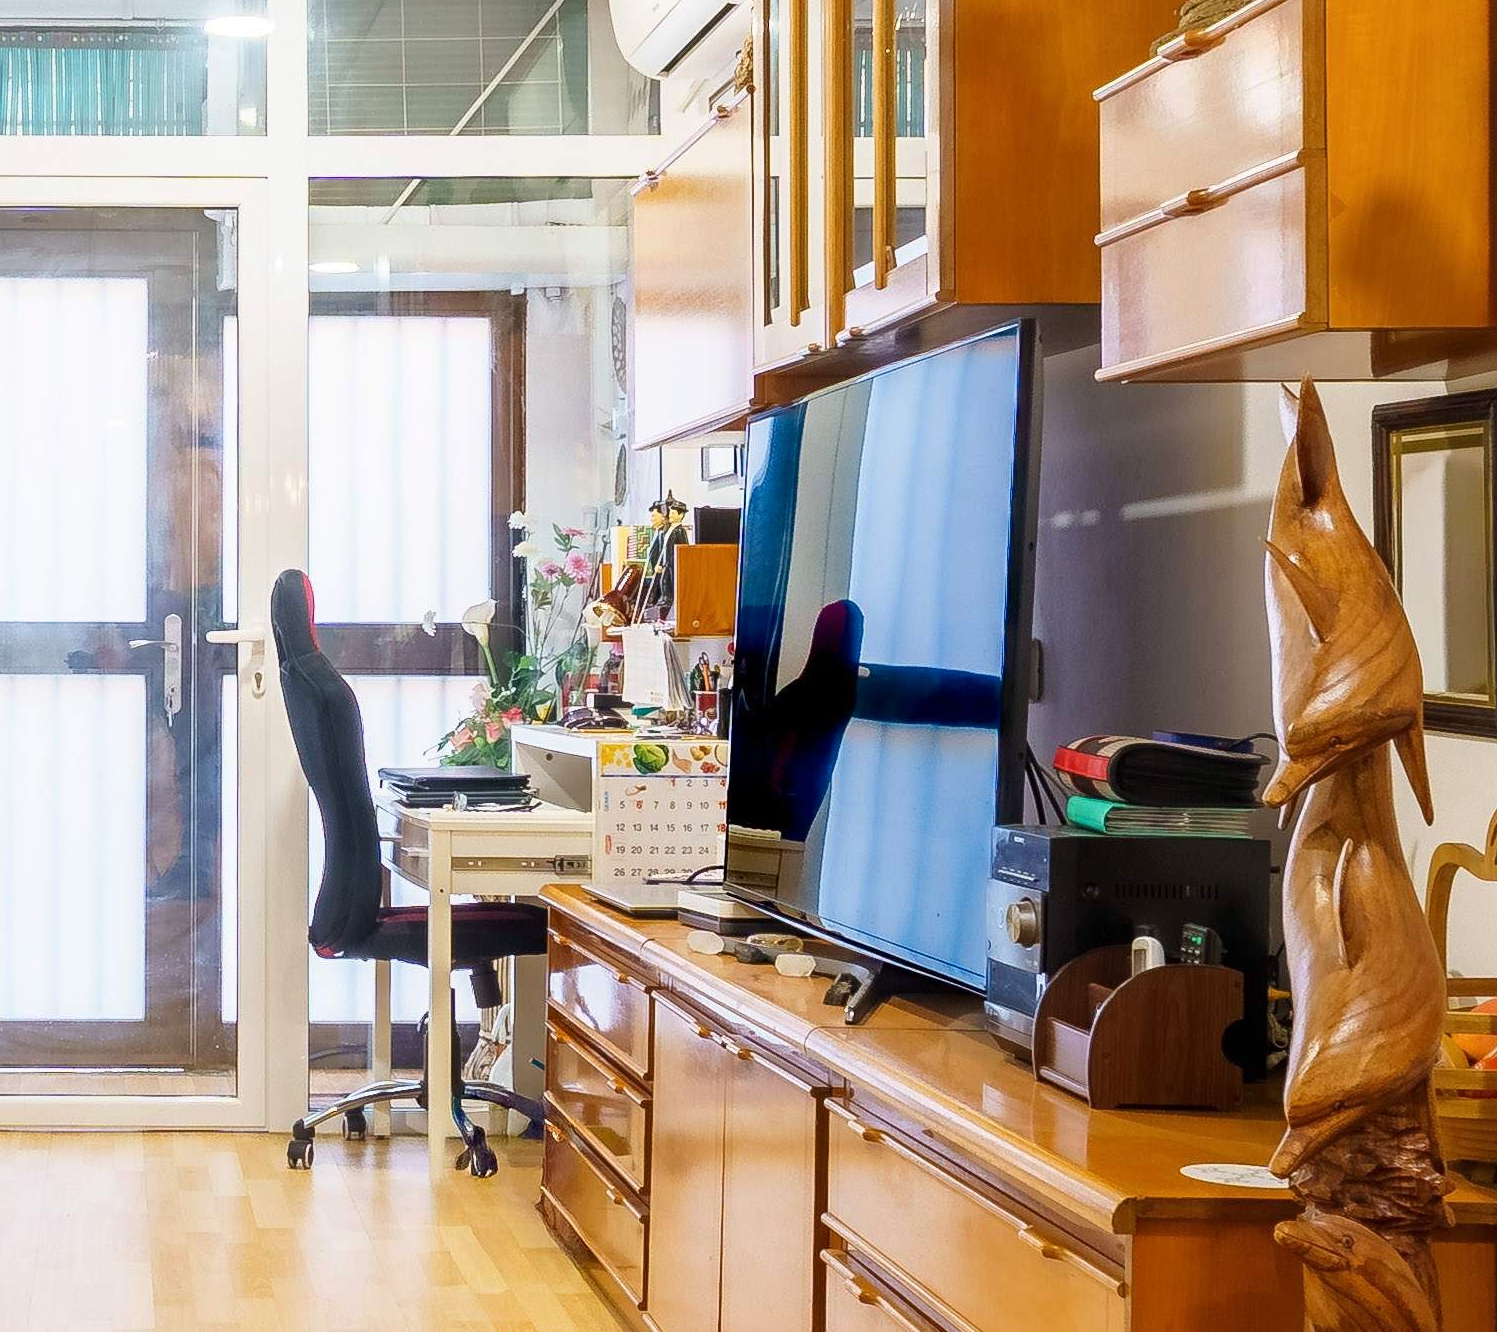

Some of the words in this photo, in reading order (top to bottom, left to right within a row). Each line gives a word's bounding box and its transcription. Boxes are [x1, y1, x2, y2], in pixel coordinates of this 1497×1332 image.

[686, 779, 692, 788] 2
[703, 779, 709, 788] 3
[619, 801, 625, 809] 5
[636, 800, 643, 809] 6
[654, 801, 660, 809] 7
[669, 801, 676, 809] 8
[686, 801, 692, 809] 9
[700, 801, 709, 809] 10
[616, 823, 625, 832] 12
[632, 823, 642, 832] 13
[649, 823, 659, 832] 14
[666, 823, 675, 832] 15
[683, 823, 692, 832] 16
[700, 823, 709, 832] 17
[616, 846, 625, 854] 19
[631, 846, 642, 854] 20
[649, 846, 659, 854] 21
[665, 846, 676, 854] 22
[682, 846, 692, 854] 23
[698, 846, 709, 854] 24
[614, 868, 625, 877] 26
[631, 868, 642, 877] 27
